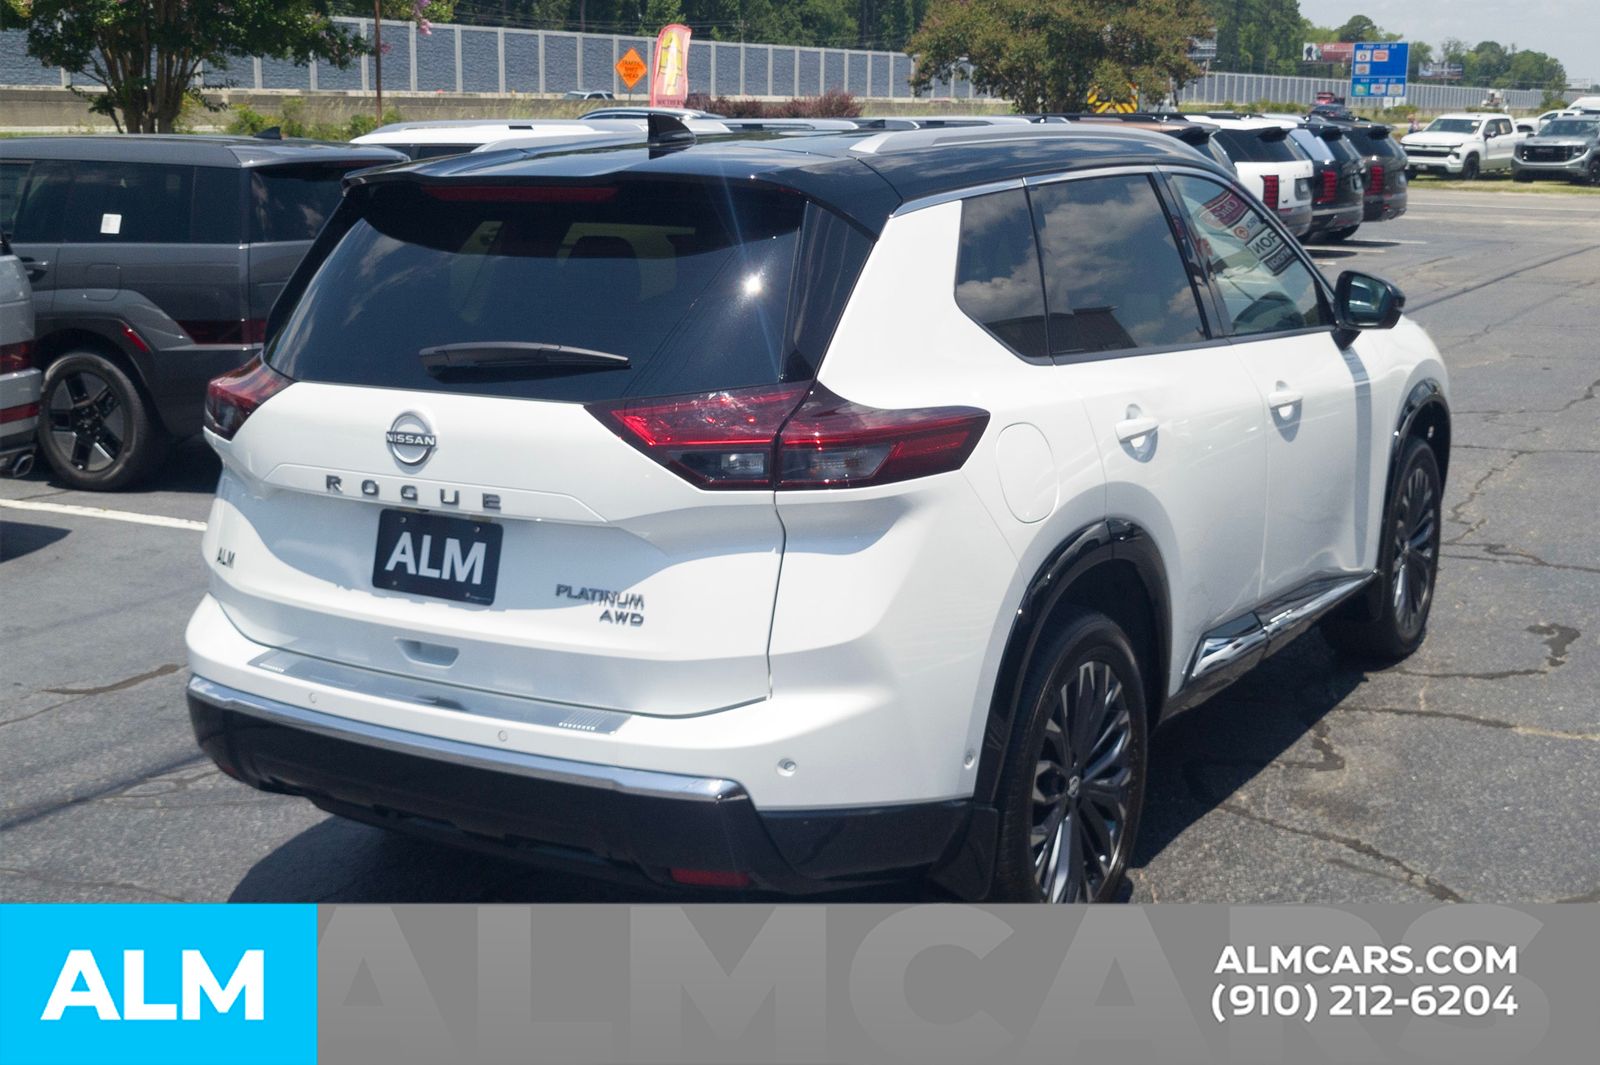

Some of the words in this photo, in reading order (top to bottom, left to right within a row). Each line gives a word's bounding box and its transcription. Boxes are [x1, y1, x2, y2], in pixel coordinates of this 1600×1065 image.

[386, 433, 435, 446] NISSAN
[326, 475, 502, 510] ROGUE
[216, 547, 235, 569] ALM
[385, 532, 487, 585] ALM
[556, 584, 644, 609] PLATINUM
[600, 609, 644, 627] AWD
